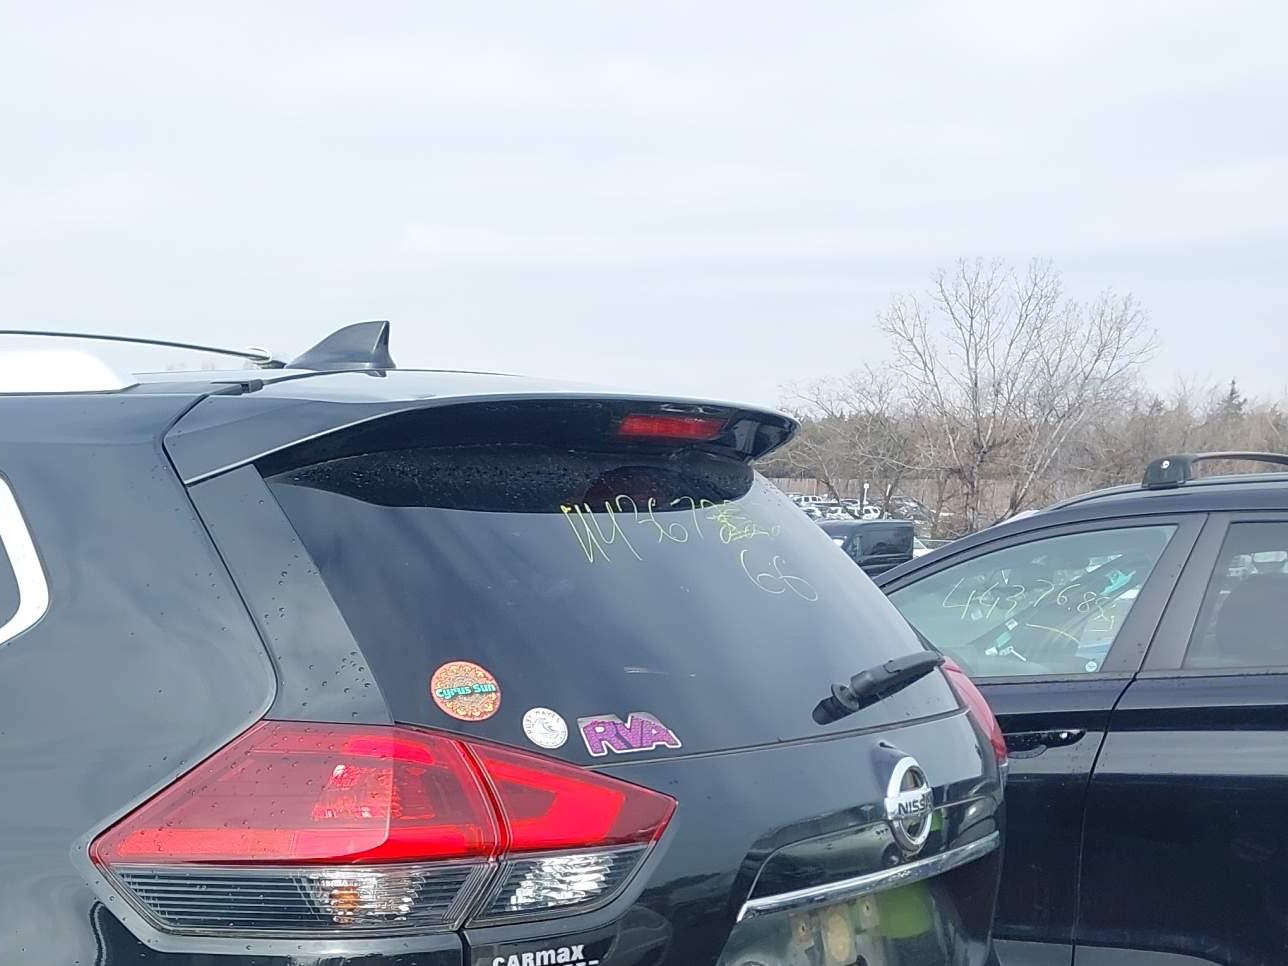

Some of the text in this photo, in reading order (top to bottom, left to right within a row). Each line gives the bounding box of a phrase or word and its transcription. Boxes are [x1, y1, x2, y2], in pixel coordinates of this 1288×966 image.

[435, 683, 497, 699] Cyrus Sun
[581, 714, 682, 757] RVA
